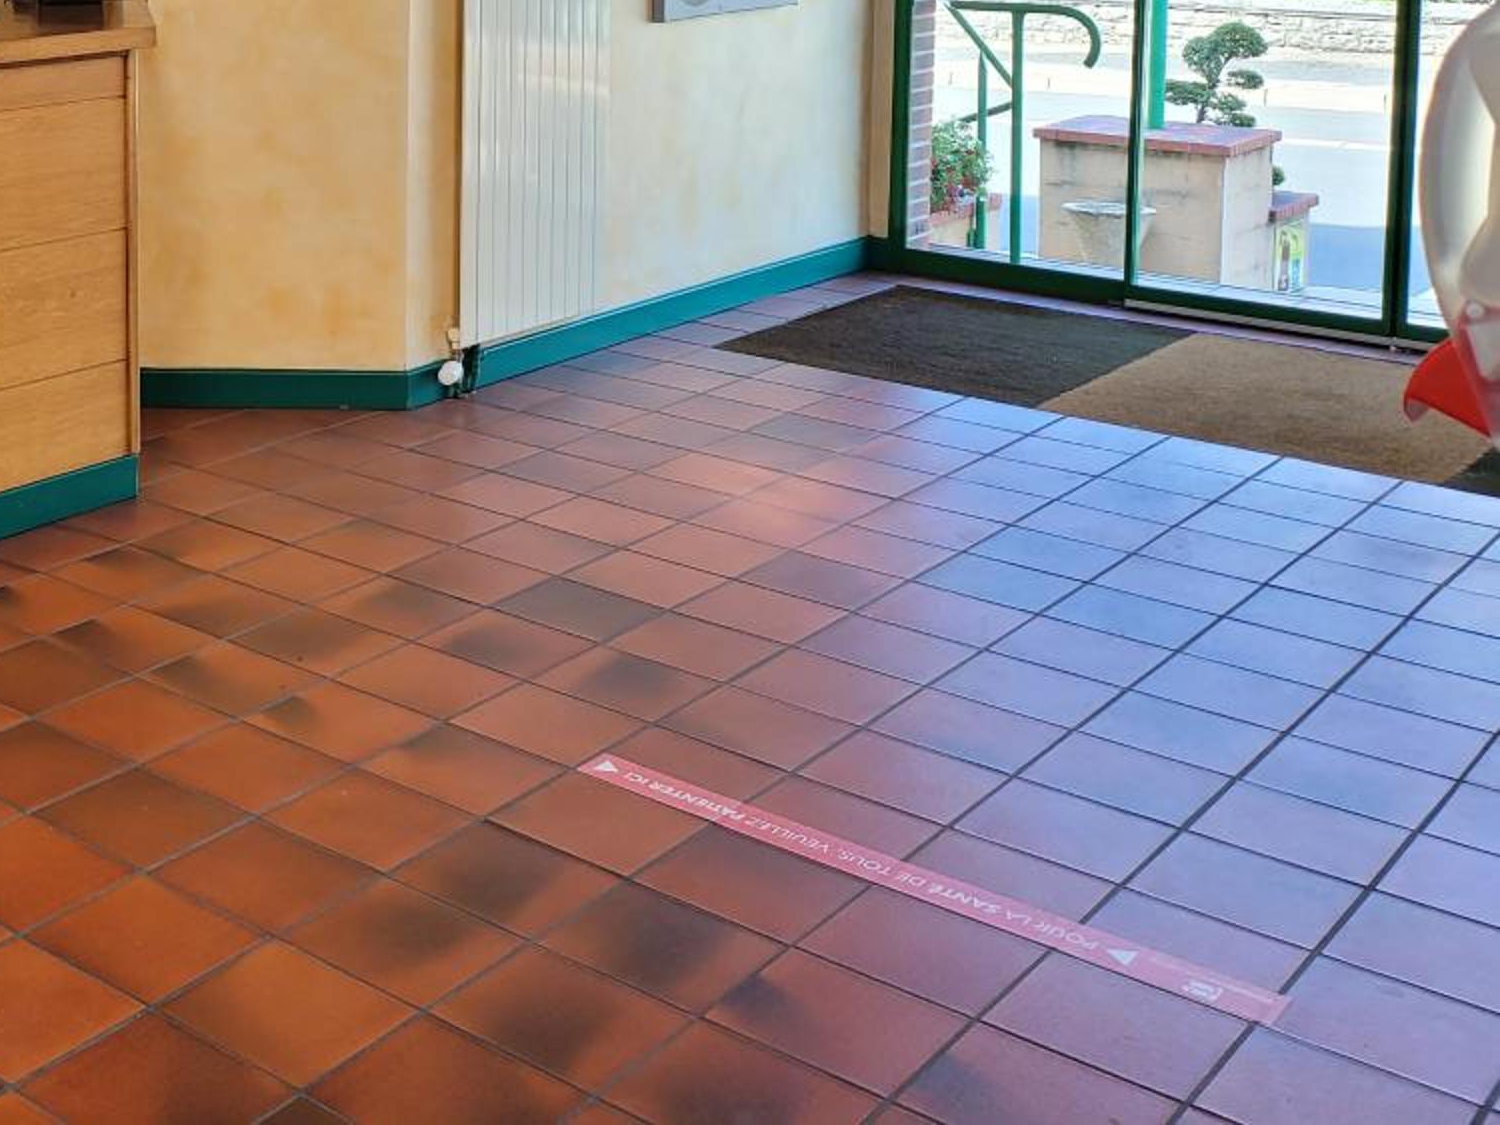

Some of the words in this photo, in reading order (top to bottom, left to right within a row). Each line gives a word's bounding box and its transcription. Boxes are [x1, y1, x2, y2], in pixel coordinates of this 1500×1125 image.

[649, 781, 747, 821] PATIENTER
[745, 815, 830, 854] VEUILLEZ
[1005, 910, 1032, 925] LA
[1040, 922, 1100, 950] POUR
